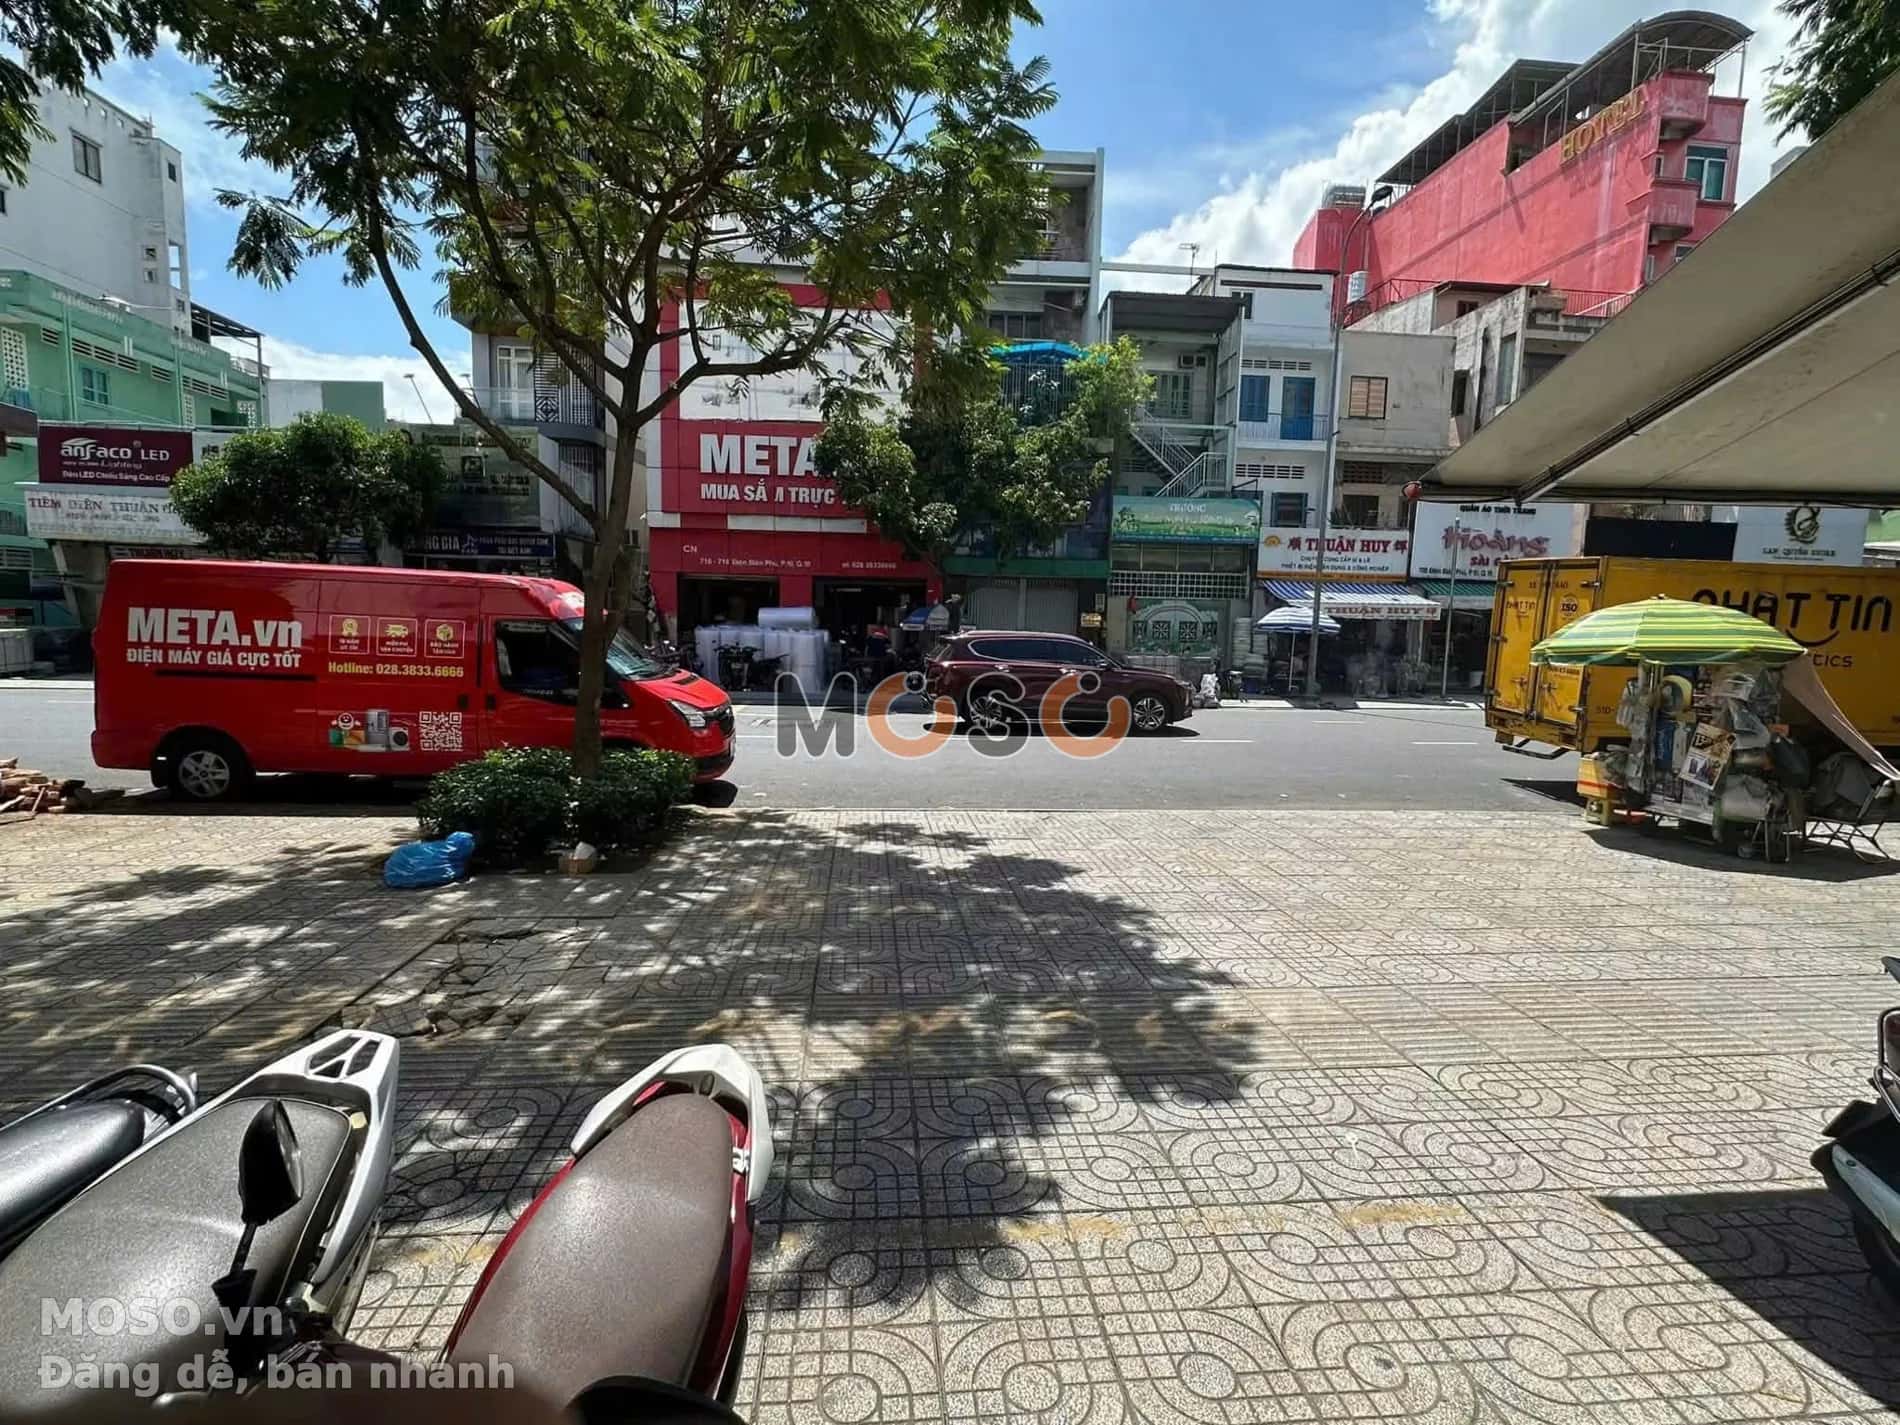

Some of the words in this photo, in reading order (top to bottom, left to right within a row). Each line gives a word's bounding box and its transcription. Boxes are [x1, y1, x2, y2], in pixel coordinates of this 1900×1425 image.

[1562, 84, 1649, 160] HOTEL
[141, 448, 170, 460] LED
[700, 483, 740, 500] MUA
[788, 487, 836, 508] TRỰC
[683, 544, 698, 553] CN
[1360, 539, 1393, 553] HUY
[1561, 602, 1578, 612] ISO
[127, 606, 303, 648] META.vn
[126, 646, 164, 667] ĐIỆN
[167, 646, 203, 665] MÁY
[207, 648, 233, 665] GIÁ
[237, 651, 270, 671] CỰC
[273, 648, 302, 668] TỐT
[328, 661, 374, 674] Hotline:
